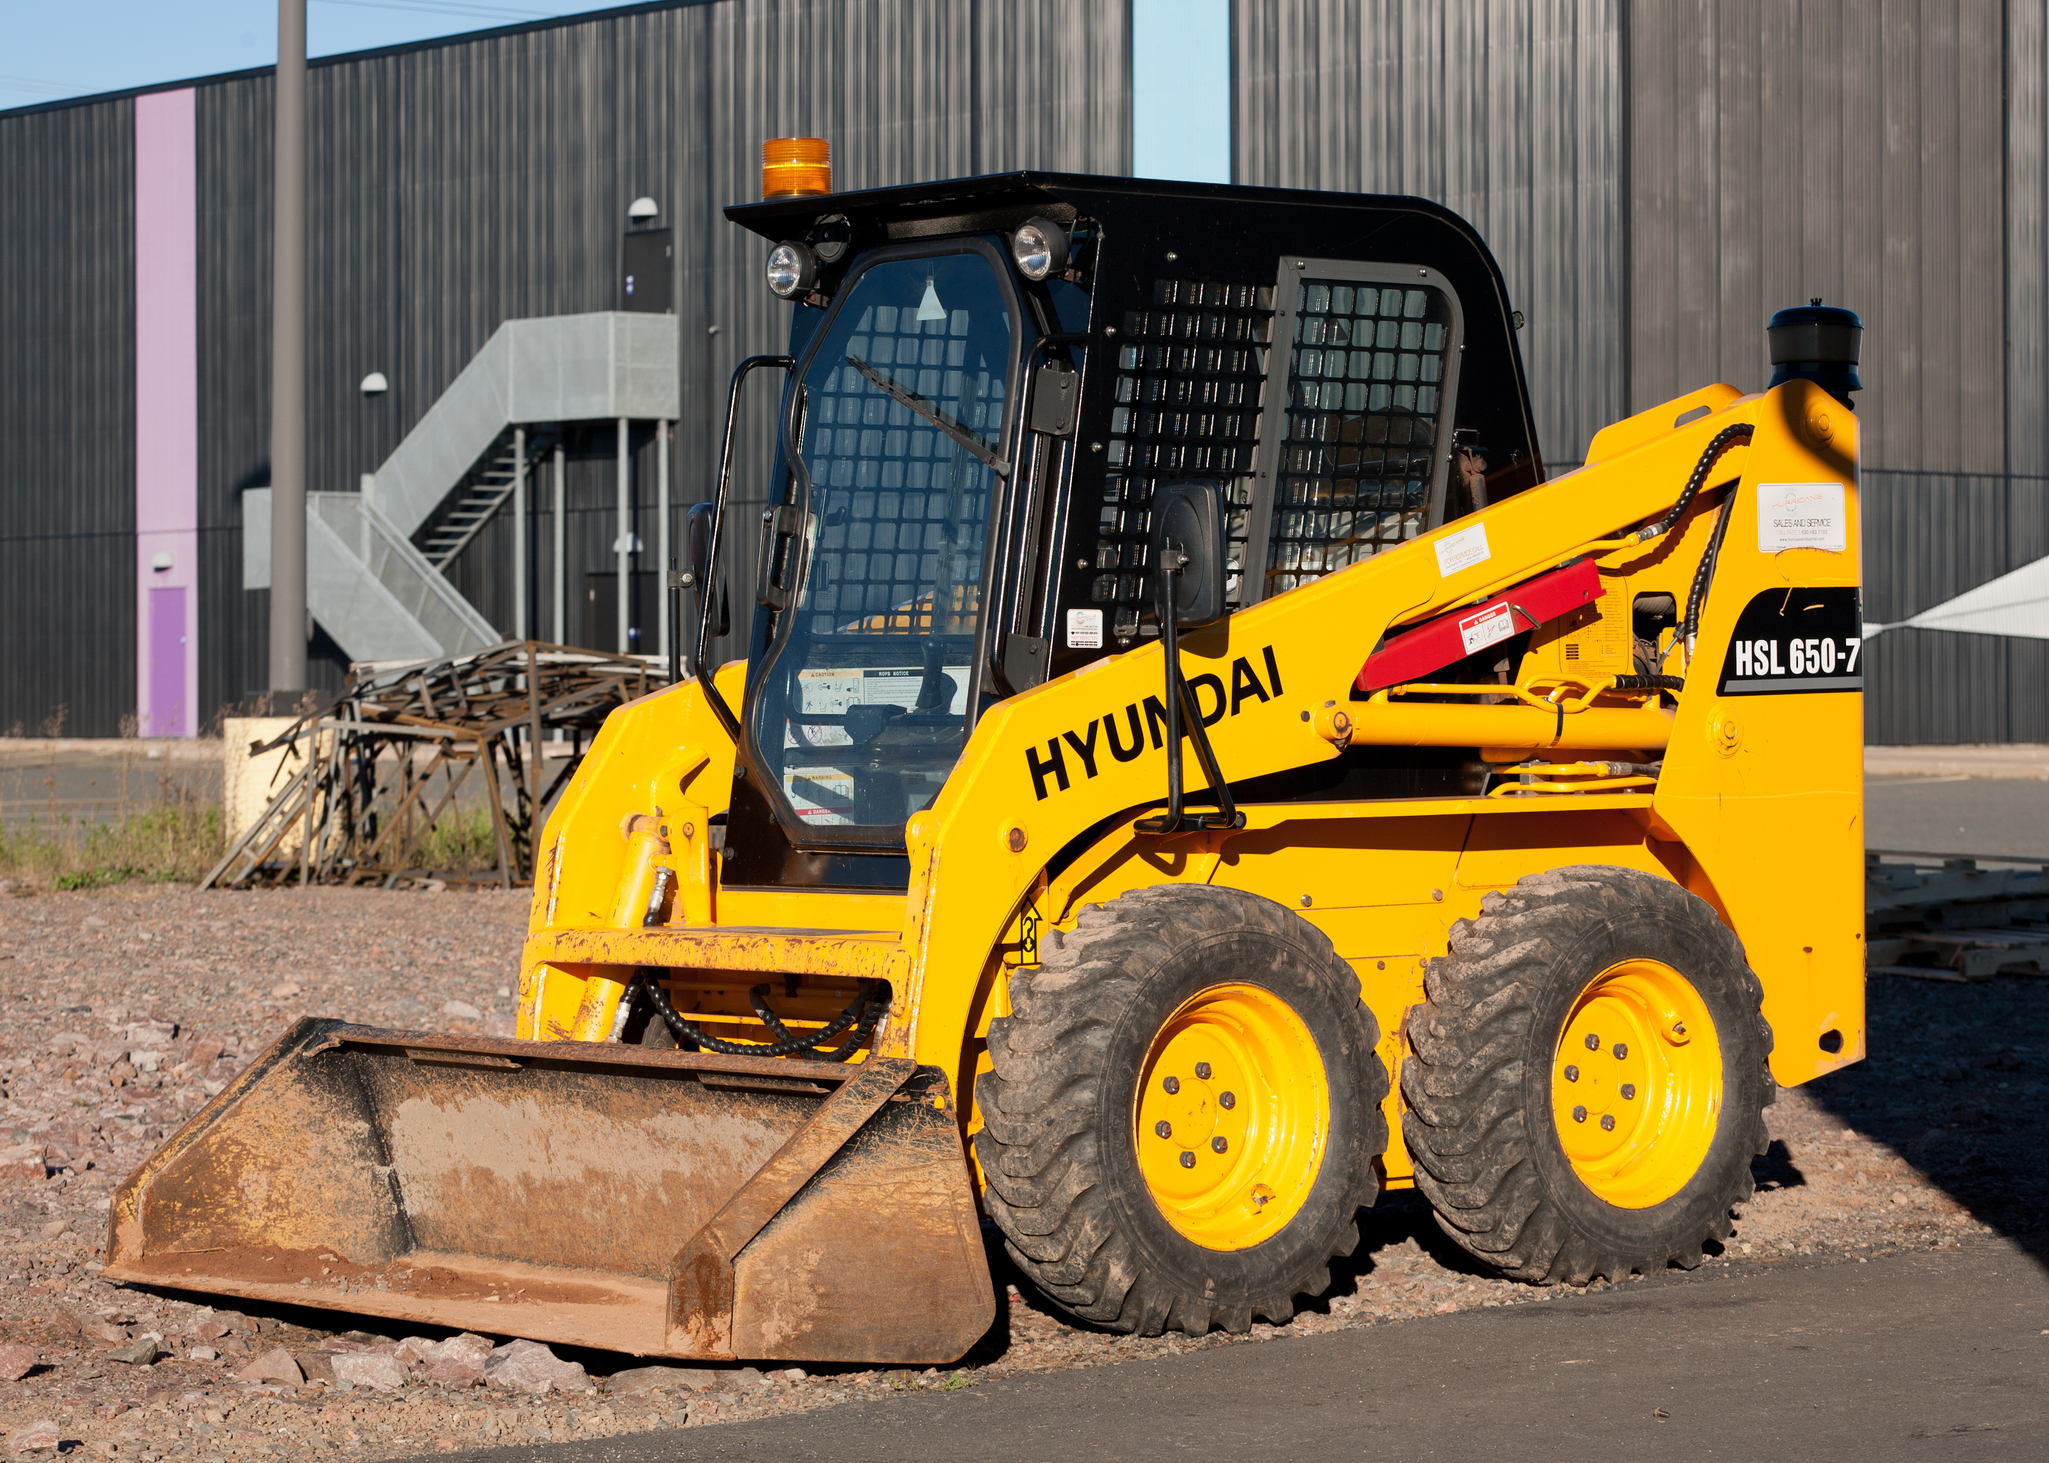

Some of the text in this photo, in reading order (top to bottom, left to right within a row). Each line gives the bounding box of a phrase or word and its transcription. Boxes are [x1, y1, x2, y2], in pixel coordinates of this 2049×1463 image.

[1773, 518, 1832, 528] SALES AND SERVICE
[1443, 556, 1454, 565] FOR
[1453, 548, 1472, 562] SERVICE
[1471, 544, 1484, 554] CALL
[1478, 611, 1497, 623] DANGER
[1735, 637, 1861, 676] HSL 650-7
[1025, 644, 1284, 801] HYUNDAI
